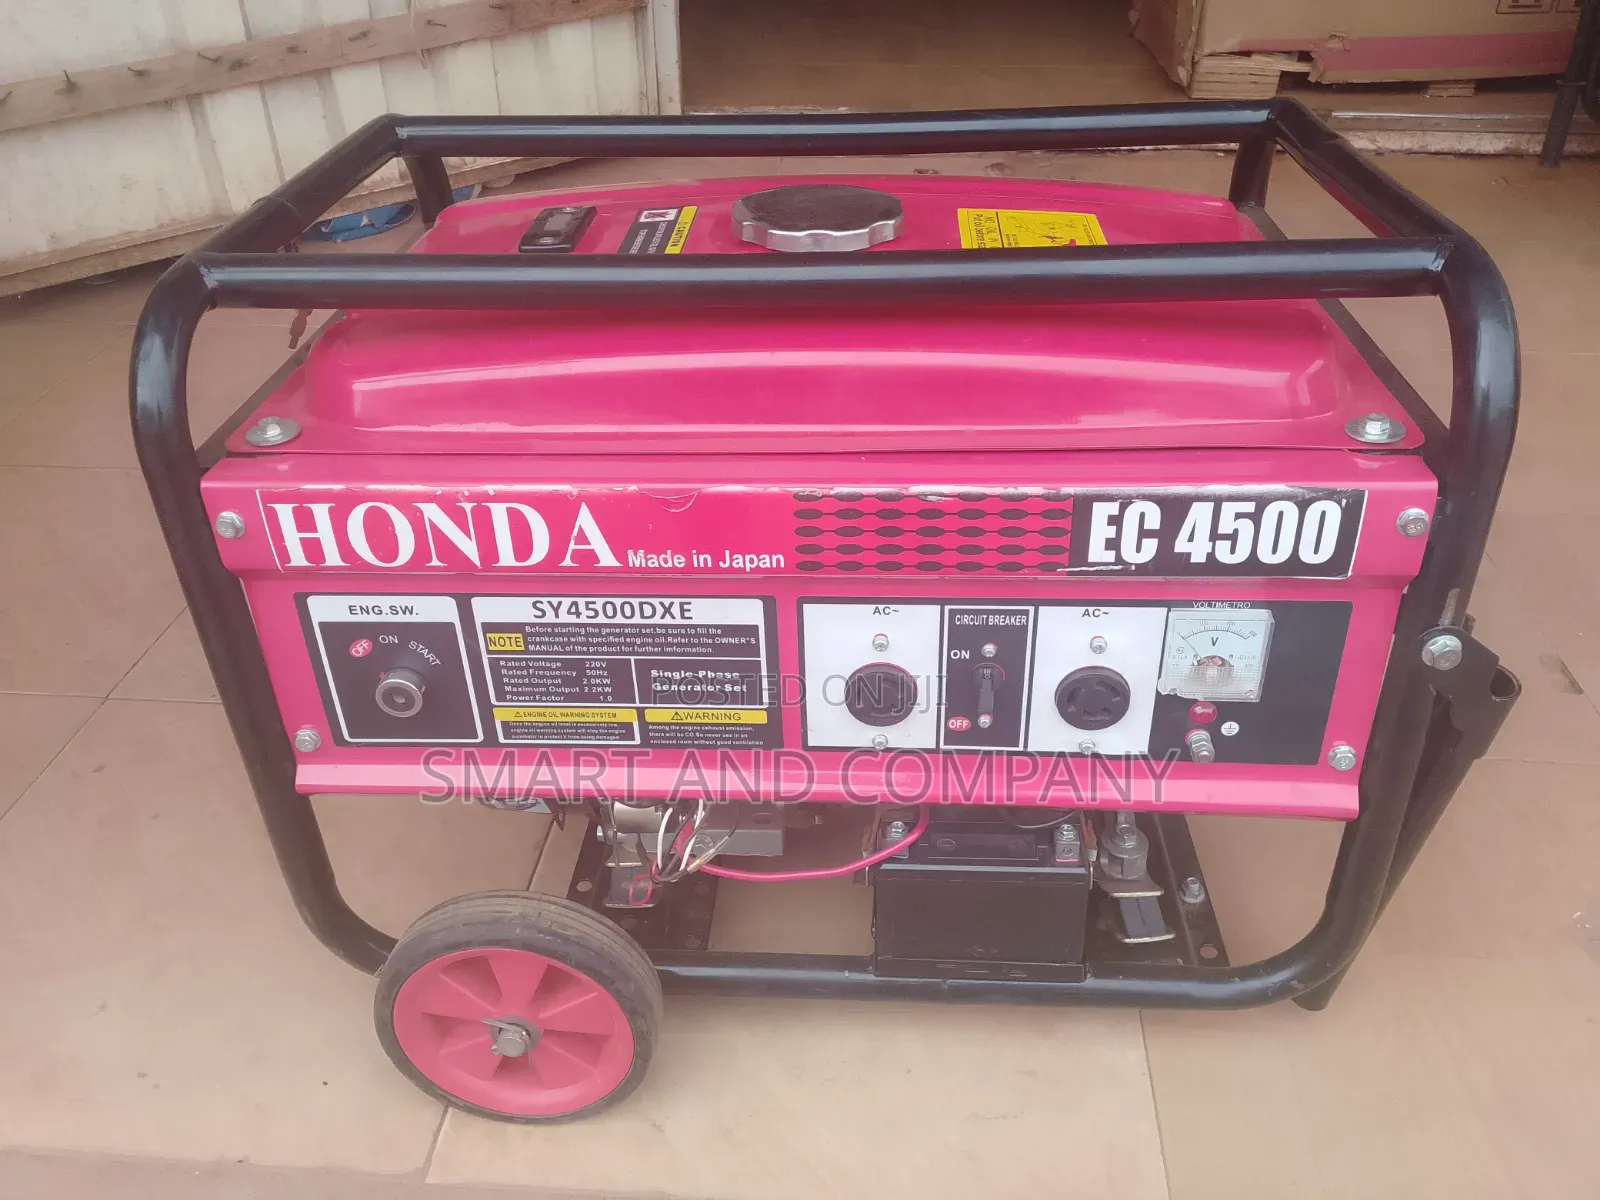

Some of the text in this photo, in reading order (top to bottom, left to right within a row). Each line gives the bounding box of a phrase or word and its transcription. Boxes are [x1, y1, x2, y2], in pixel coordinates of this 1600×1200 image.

[267, 501, 623, 568] HONDA
[1087, 499, 1342, 565] EC 4500
[627, 550, 785, 572] Made in Japan
[348, 605, 419, 616] ENG.SW.
[531, 600, 693, 620] SY4500DXE
[1192, 601, 1251, 610] VOLTIMETRO
[955, 614, 1027, 626] CIRCUIT BREAKER
[554, 626, 585, 634] starting
[601, 627, 640, 635] generator
[379, 635, 399, 644] ON
[488, 636, 523, 648] NOTE
[1211, 636, 1219, 647] V
[351, 640, 370, 656] OFF
[589, 645, 620, 653] product
[634, 645, 662, 653] further
[408, 641, 441, 666] START
[950, 650, 970, 660] ON
[527, 660, 562, 669] Voltage
[529, 669, 577, 677] Frequency
[651, 669, 740, 679] Single-Phase
[530, 677, 562, 686] Output
[548, 686, 580, 694] Output
[652, 682, 747, 692] Generator Set
[560, 711, 590, 719] WARNING
[683, 712, 742, 721] WARNING
[949, 719, 969, 729] OFF
